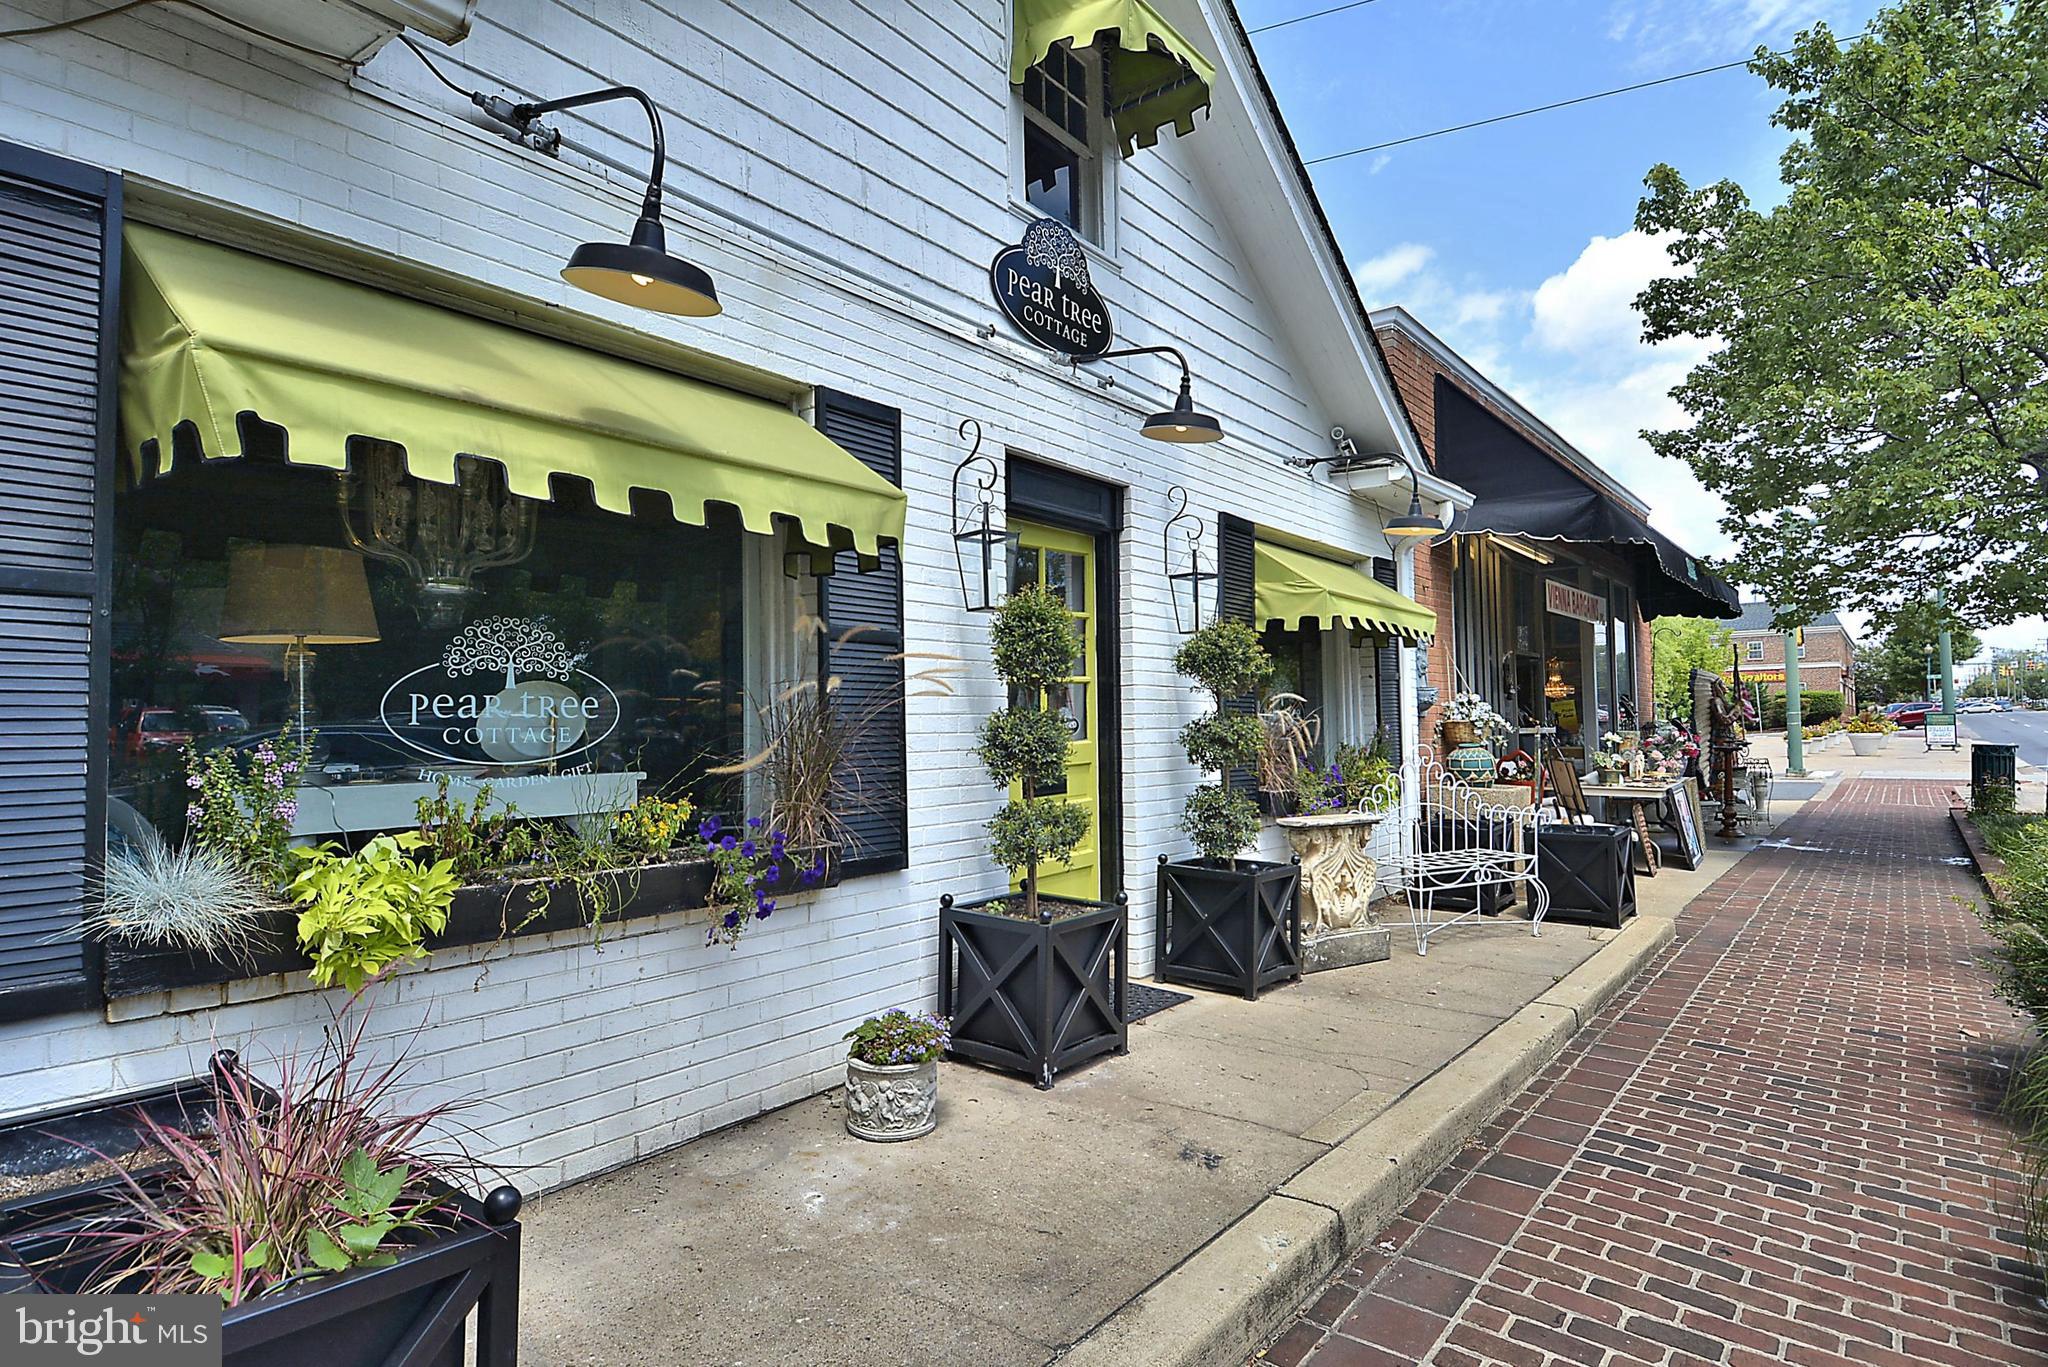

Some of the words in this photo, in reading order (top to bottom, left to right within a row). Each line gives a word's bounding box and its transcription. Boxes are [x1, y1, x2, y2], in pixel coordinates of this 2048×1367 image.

[1023, 305, 1088, 348] COTTAGE
[442, 727, 572, 745] COTTAGE
[417, 767, 472, 787] HOME
[561, 761, 593, 779] GIFT
